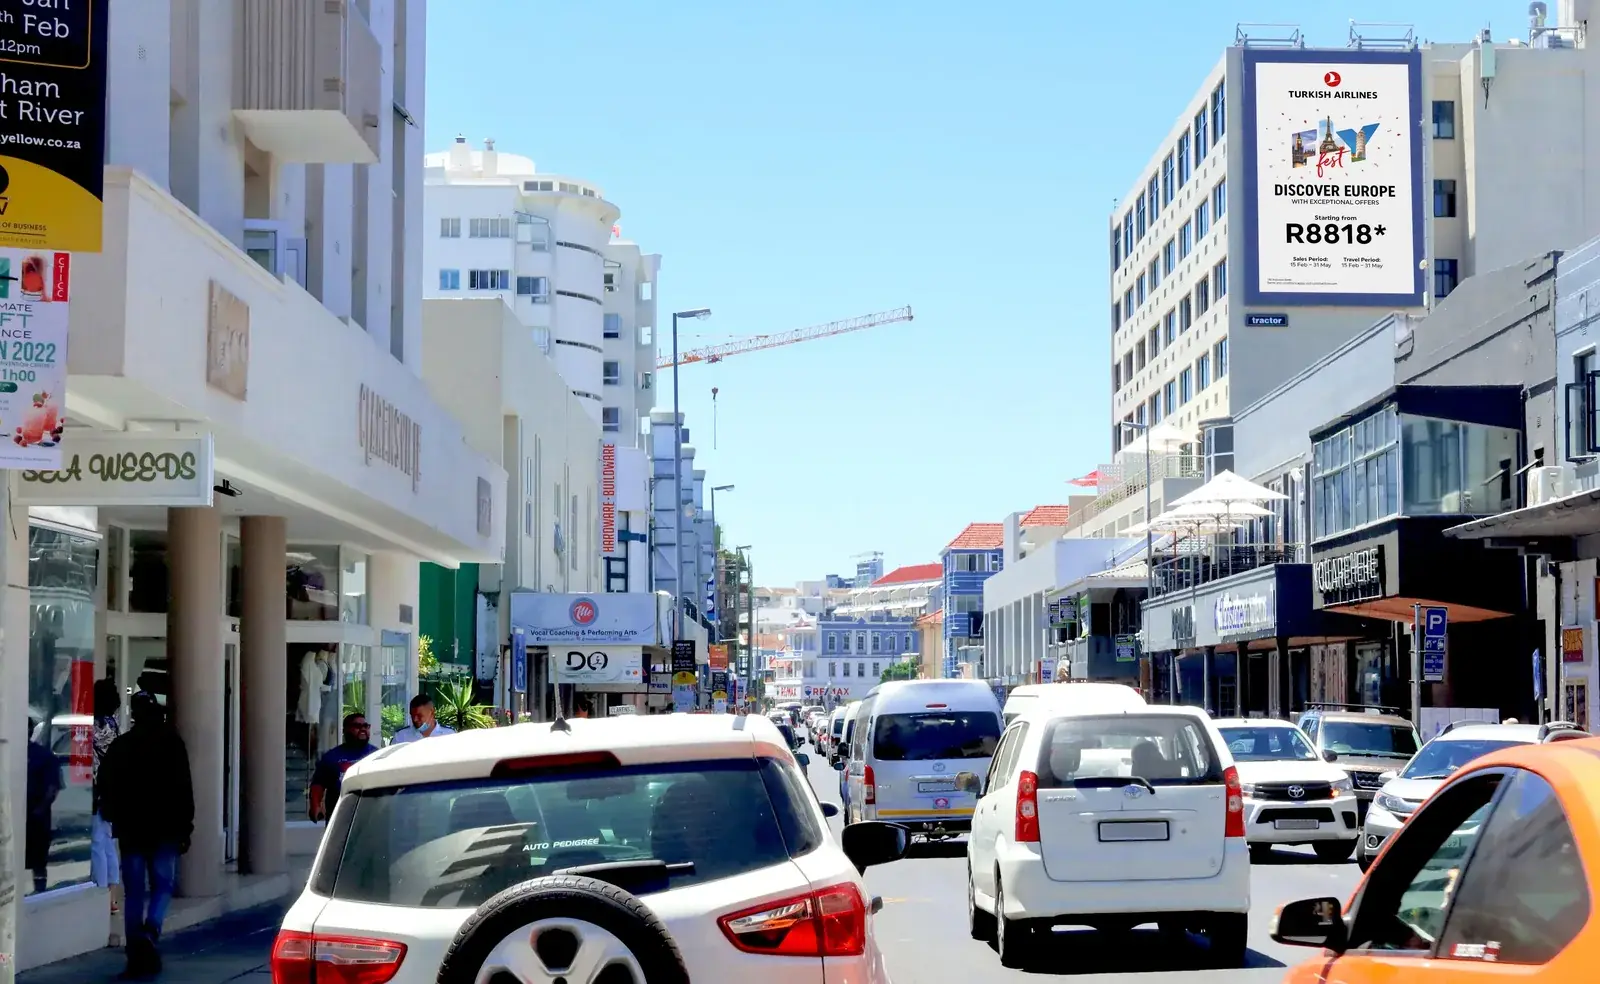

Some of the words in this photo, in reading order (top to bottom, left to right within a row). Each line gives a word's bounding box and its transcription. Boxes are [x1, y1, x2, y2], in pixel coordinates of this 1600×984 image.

[23, 13, 69, 38] Feb
[0, 72, 60, 98] ham
[1288, 90, 1331, 98] TURKISH
[1334, 91, 1378, 99] AIRLINES
[18, 100, 84, 125] River
[1316, 146, 1350, 178] fest
[1274, 184, 1340, 197] DISCOVER
[1344, 185, 1396, 198] EUROPE
[13, 222, 47, 231] BUSINESS
[57, 257, 65, 298] CTICC
[1252, 316, 1283, 325] tractor
[1, 329, 33, 339] NCE
[12, 341, 56, 363] 2022
[88, 451, 196, 483] WEEDS
[603, 501, 615, 553] HARDWARE
[1429, 614, 1443, 630] P
[549, 629, 580, 637] Coaching
[587, 629, 623, 637] Performing
[522, 842, 550, 852] AUTO
[552, 837, 600, 849] PEDIGREE
